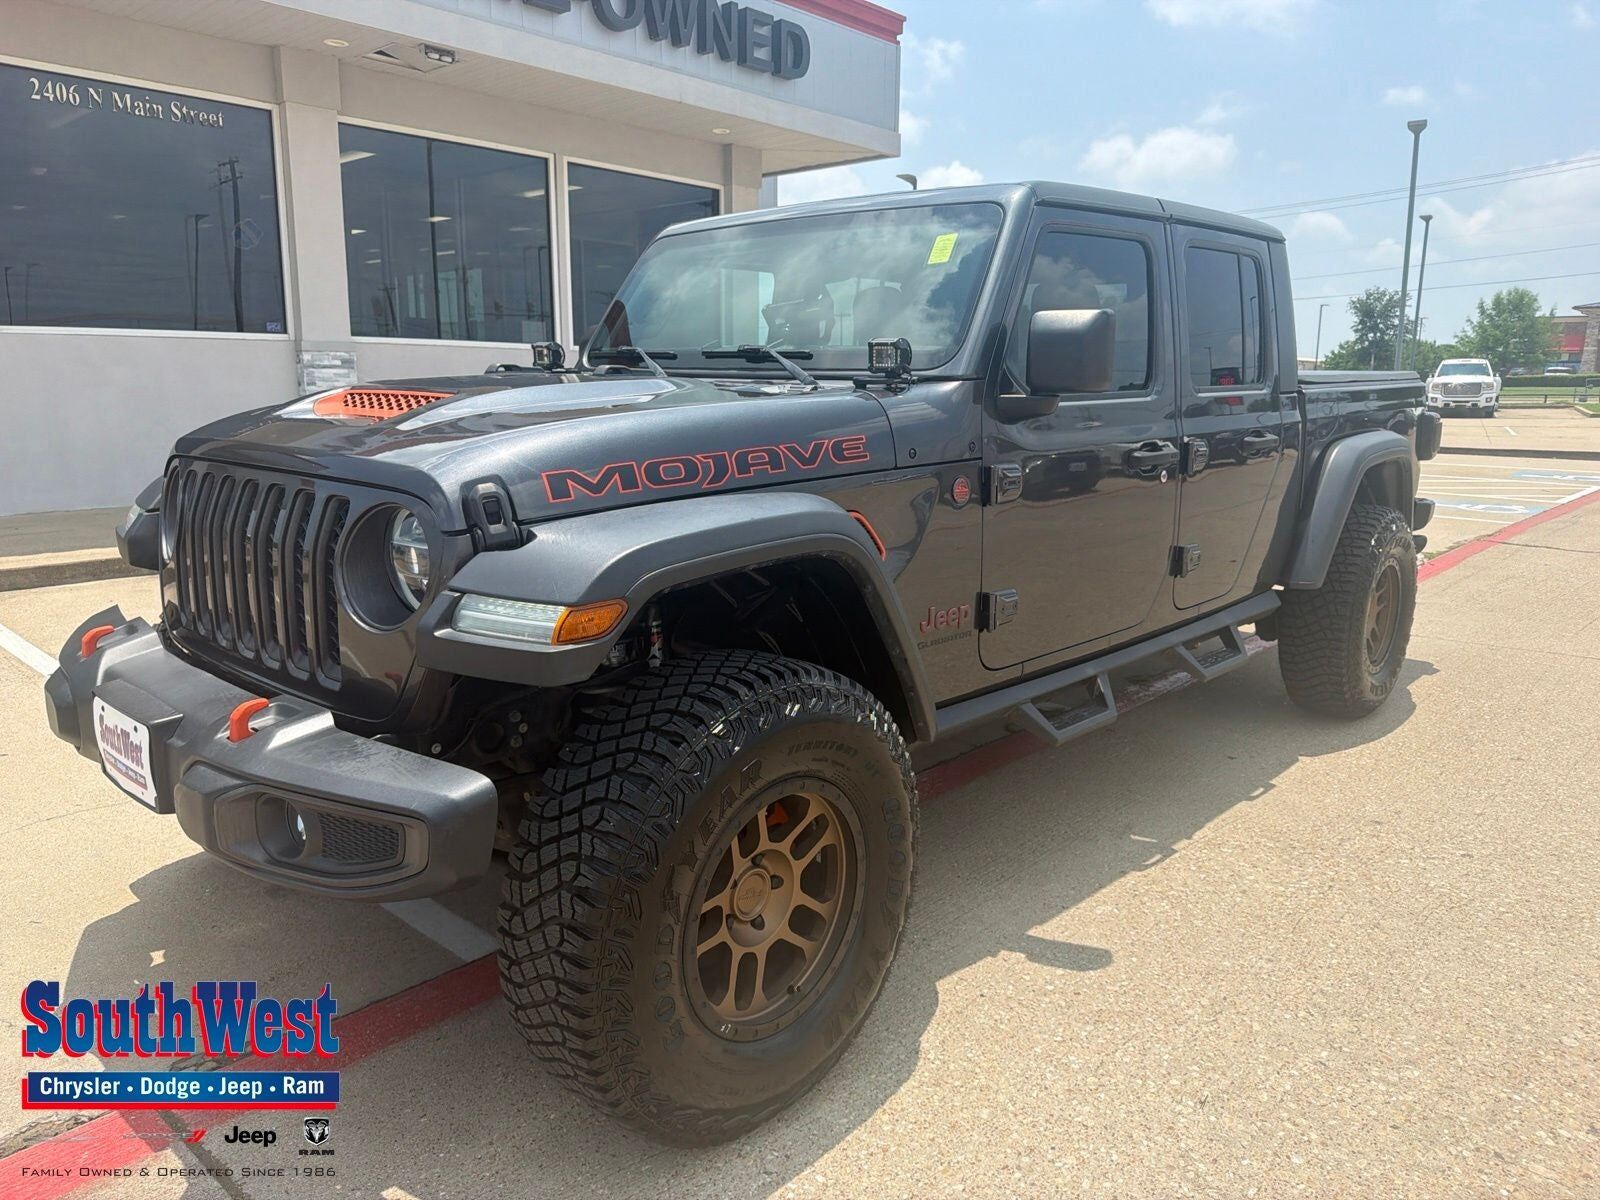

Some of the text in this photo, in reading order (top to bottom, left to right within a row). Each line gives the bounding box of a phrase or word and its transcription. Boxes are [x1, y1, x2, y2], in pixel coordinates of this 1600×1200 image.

[29, 77, 225, 127] 2406 N Main Street
[541, 435, 870, 503] MOJAVE
[920, 604, 971, 634] Jeep
